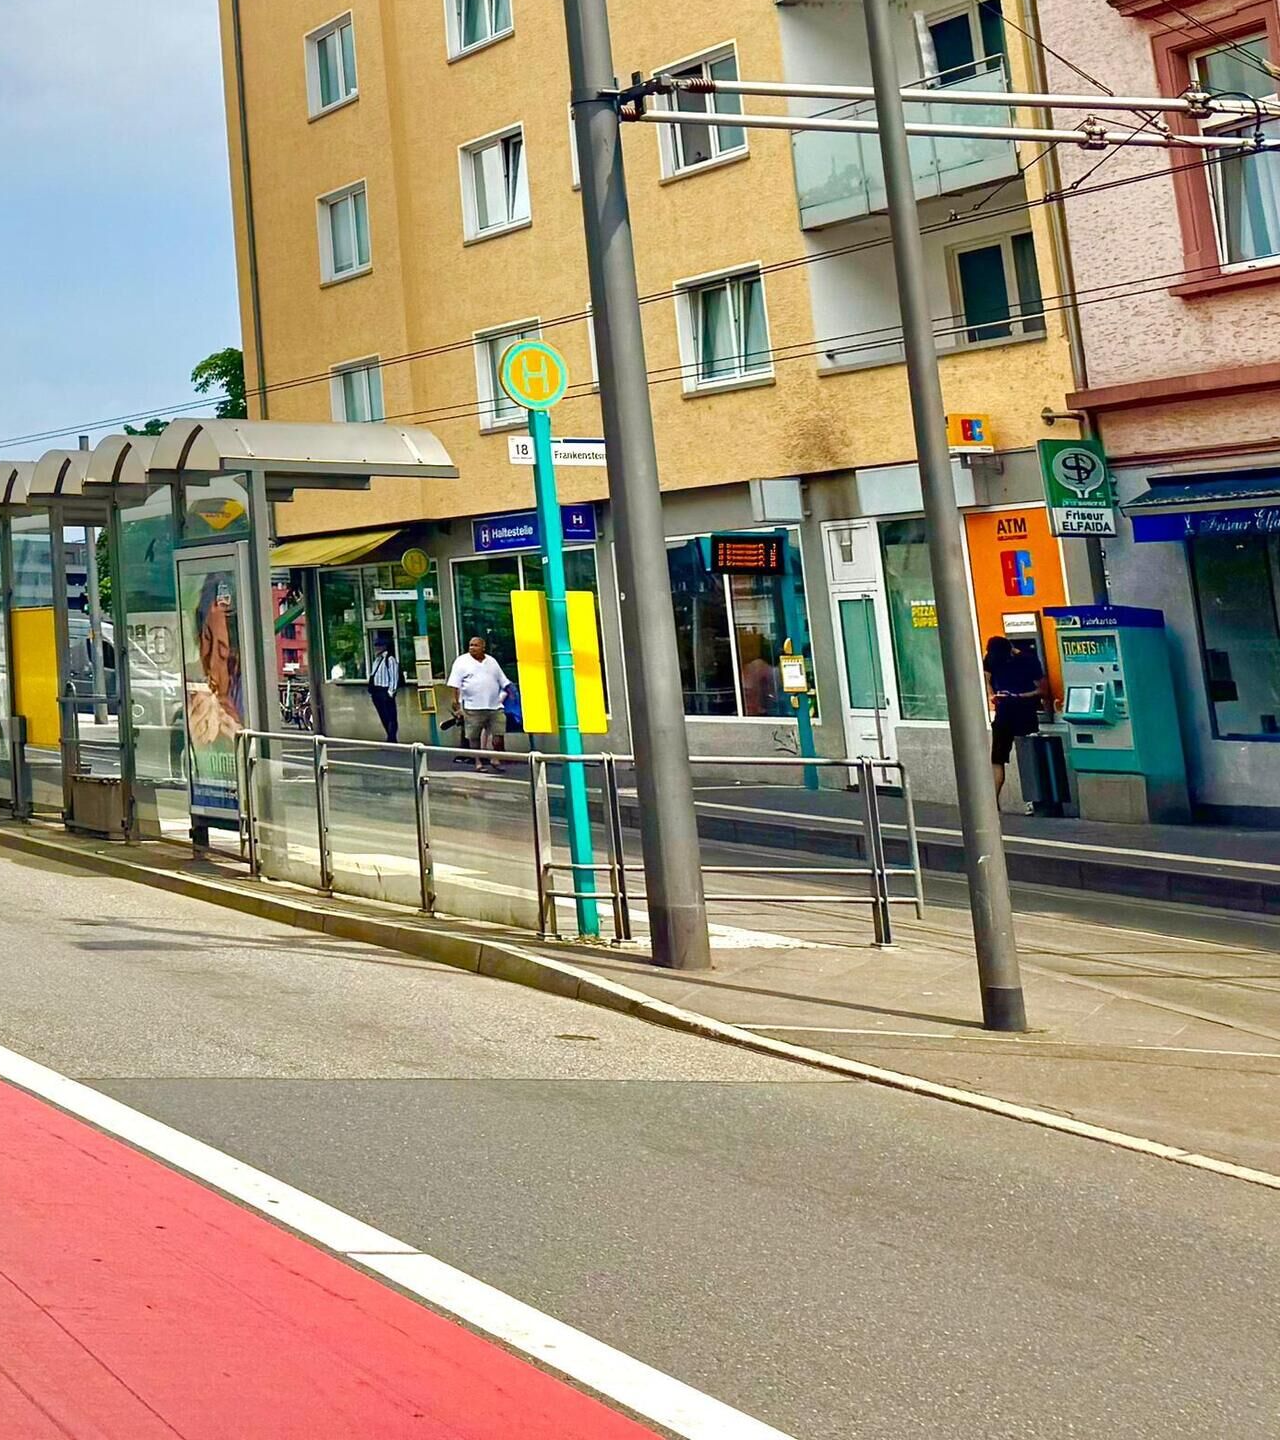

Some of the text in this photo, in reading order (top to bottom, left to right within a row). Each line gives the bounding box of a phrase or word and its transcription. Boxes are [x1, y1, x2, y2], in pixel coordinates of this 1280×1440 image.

[515, 444, 529, 456] 18
[1065, 510, 1104, 520] Friseur
[492, 525, 534, 539] Haltestelle
[997, 517, 1027, 535] ATM
[1062, 521, 1112, 532] ELFAIDA
[1063, 641, 1097, 655] TICKETS
